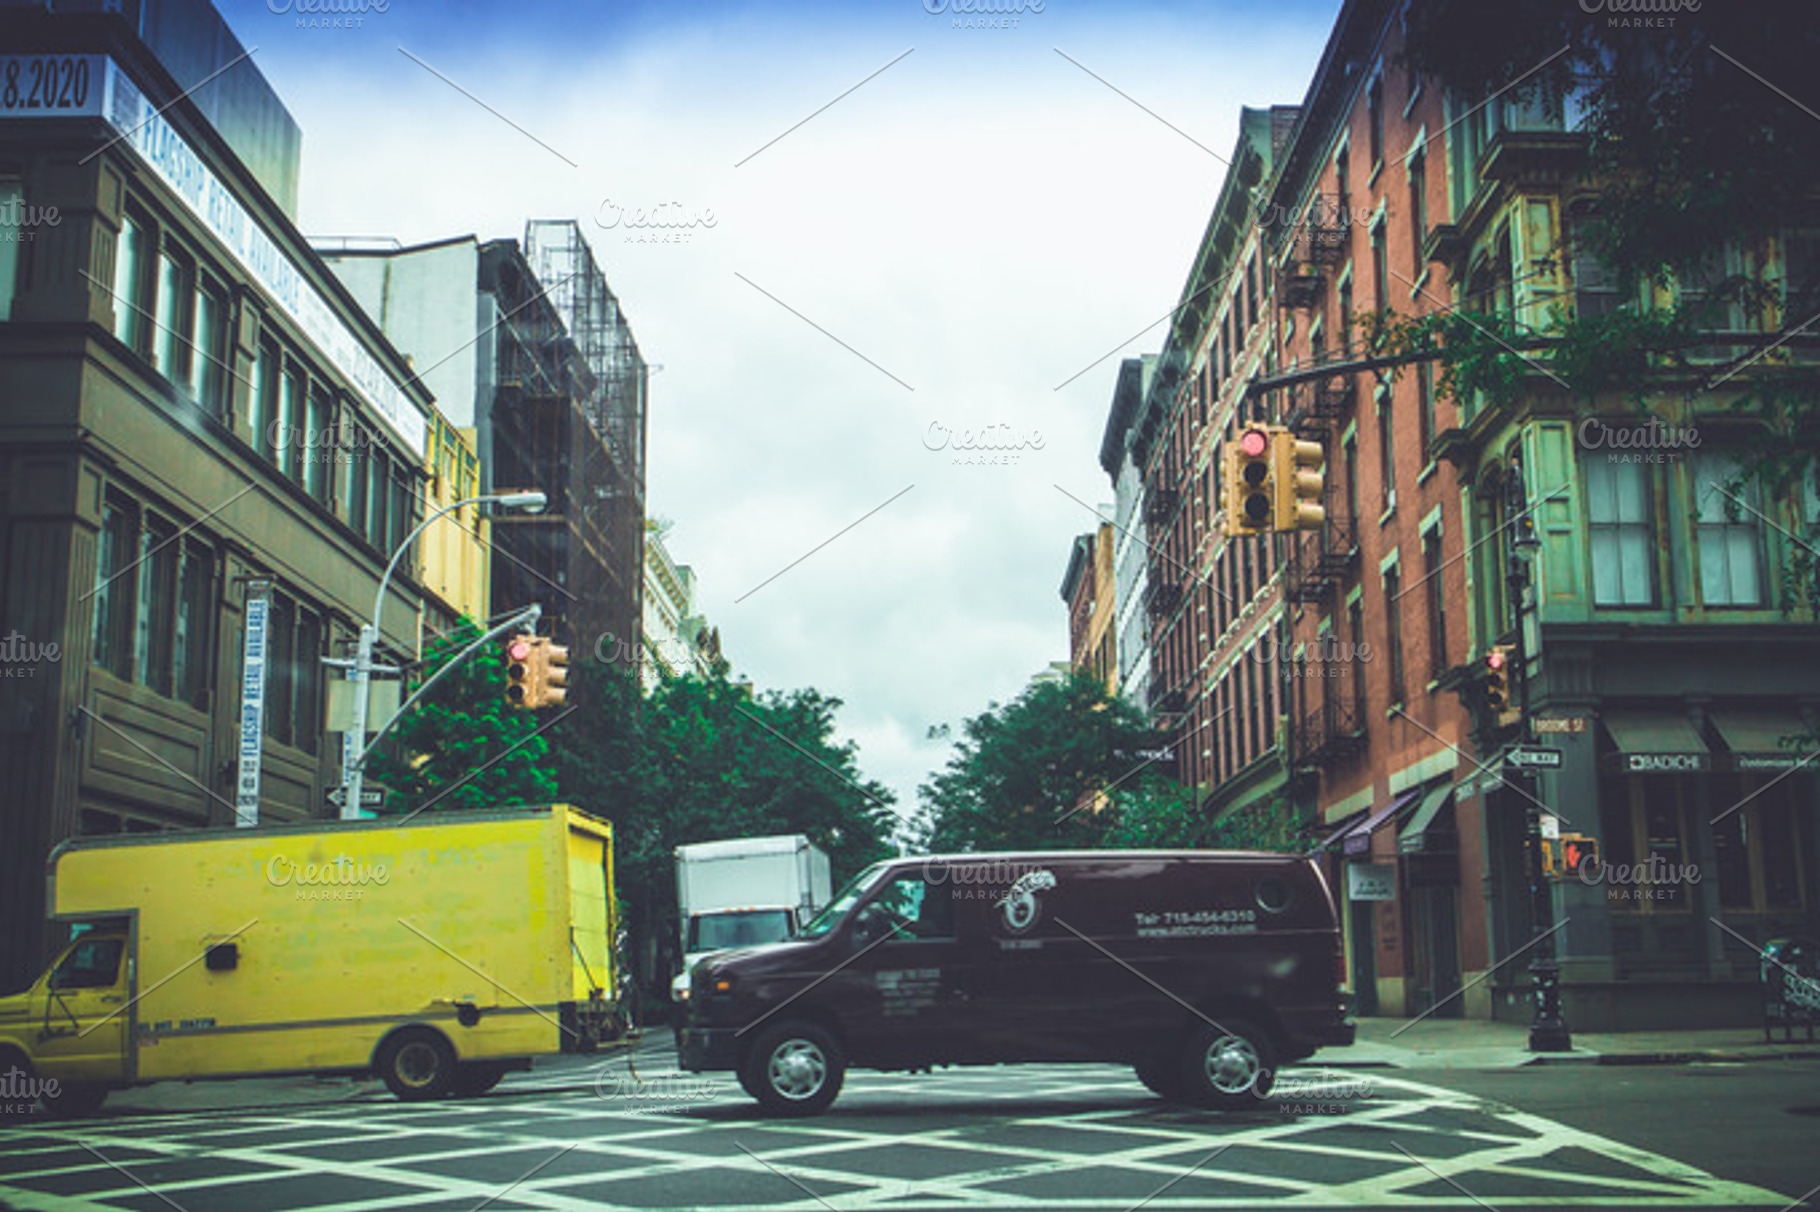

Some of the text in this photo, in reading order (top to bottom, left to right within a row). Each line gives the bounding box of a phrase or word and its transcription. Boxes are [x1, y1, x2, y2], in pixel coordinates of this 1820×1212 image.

[4, 58, 89, 109] 8.2020
[144, 103, 203, 209] FLAGSHIP
[244, 663, 262, 700] RETAIL
[241, 703, 259, 756] FLAGSHIP
